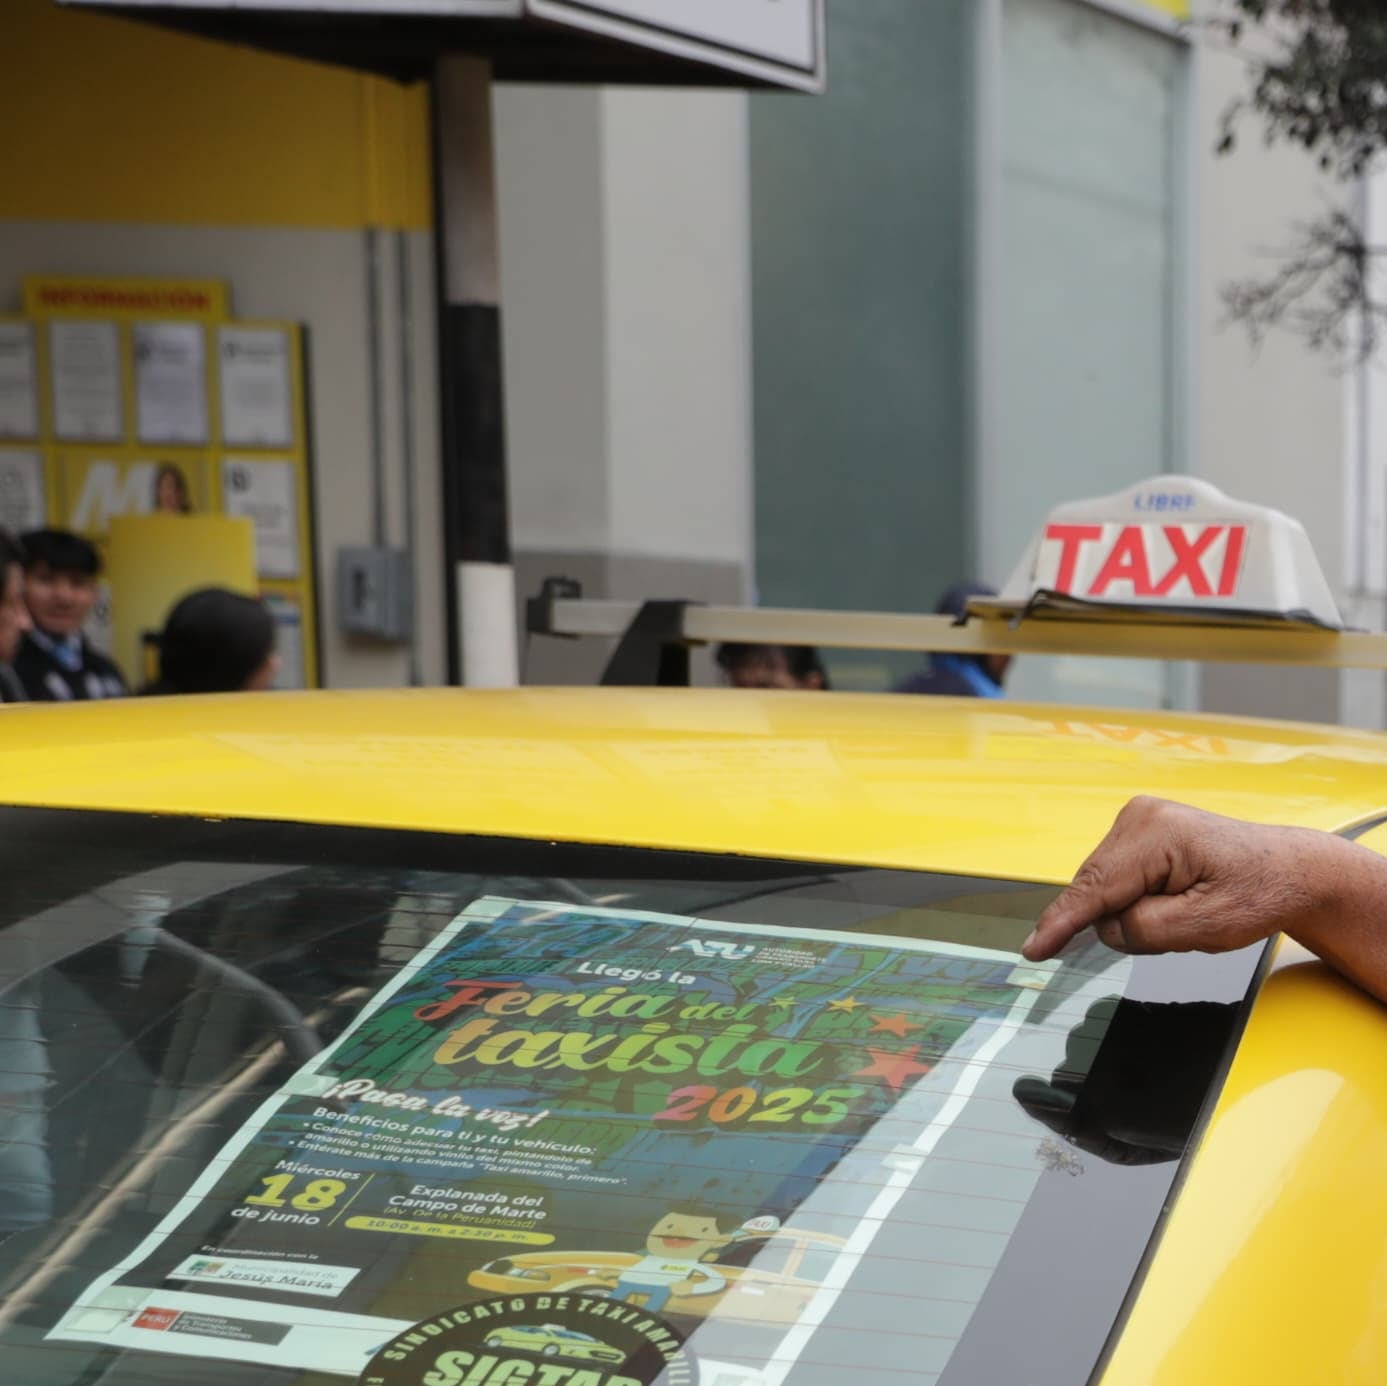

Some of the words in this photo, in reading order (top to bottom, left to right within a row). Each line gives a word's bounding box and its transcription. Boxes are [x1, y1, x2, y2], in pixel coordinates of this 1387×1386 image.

[1045, 523, 1247, 597] TAXI
[576, 961, 662, 982] Llegó
[668, 970, 697, 985] la
[413, 979, 677, 1022] Feria
[679, 1002, 758, 1021] del
[433, 1018, 825, 1077] taxista
[432, 1096, 471, 1117] la
[651, 1084, 866, 1125] 2025
[304, 1132, 359, 1147] amarillo
[312, 1122, 363, 1137] Conoce
[364, 1129, 402, 1144] cómo
[313, 1107, 410, 1132] Beneficios
[410, 1125, 454, 1139] para
[457, 1129, 473, 1140] ti
[473, 1132, 487, 1143] y
[489, 1134, 510, 1145] tu
[514, 1136, 598, 1154] vehículo:
[297, 1139, 352, 1156] Entérate
[354, 1150, 382, 1161] más
[274, 1159, 361, 1181] Miércoles
[244, 1173, 347, 1212] 18
[410, 1184, 508, 1205] Explanada
[511, 1196, 544, 1208] del
[231, 1207, 260, 1219] de
[257, 1209, 321, 1226] junio
[388, 1195, 458, 1212] Campo
[461, 1201, 487, 1213] de
[489, 1205, 547, 1220] Marte
[383, 1297, 526, 1361] SINDICATO
[536, 1296, 570, 1310] DE
[577, 1298, 640, 1324] TAXI
